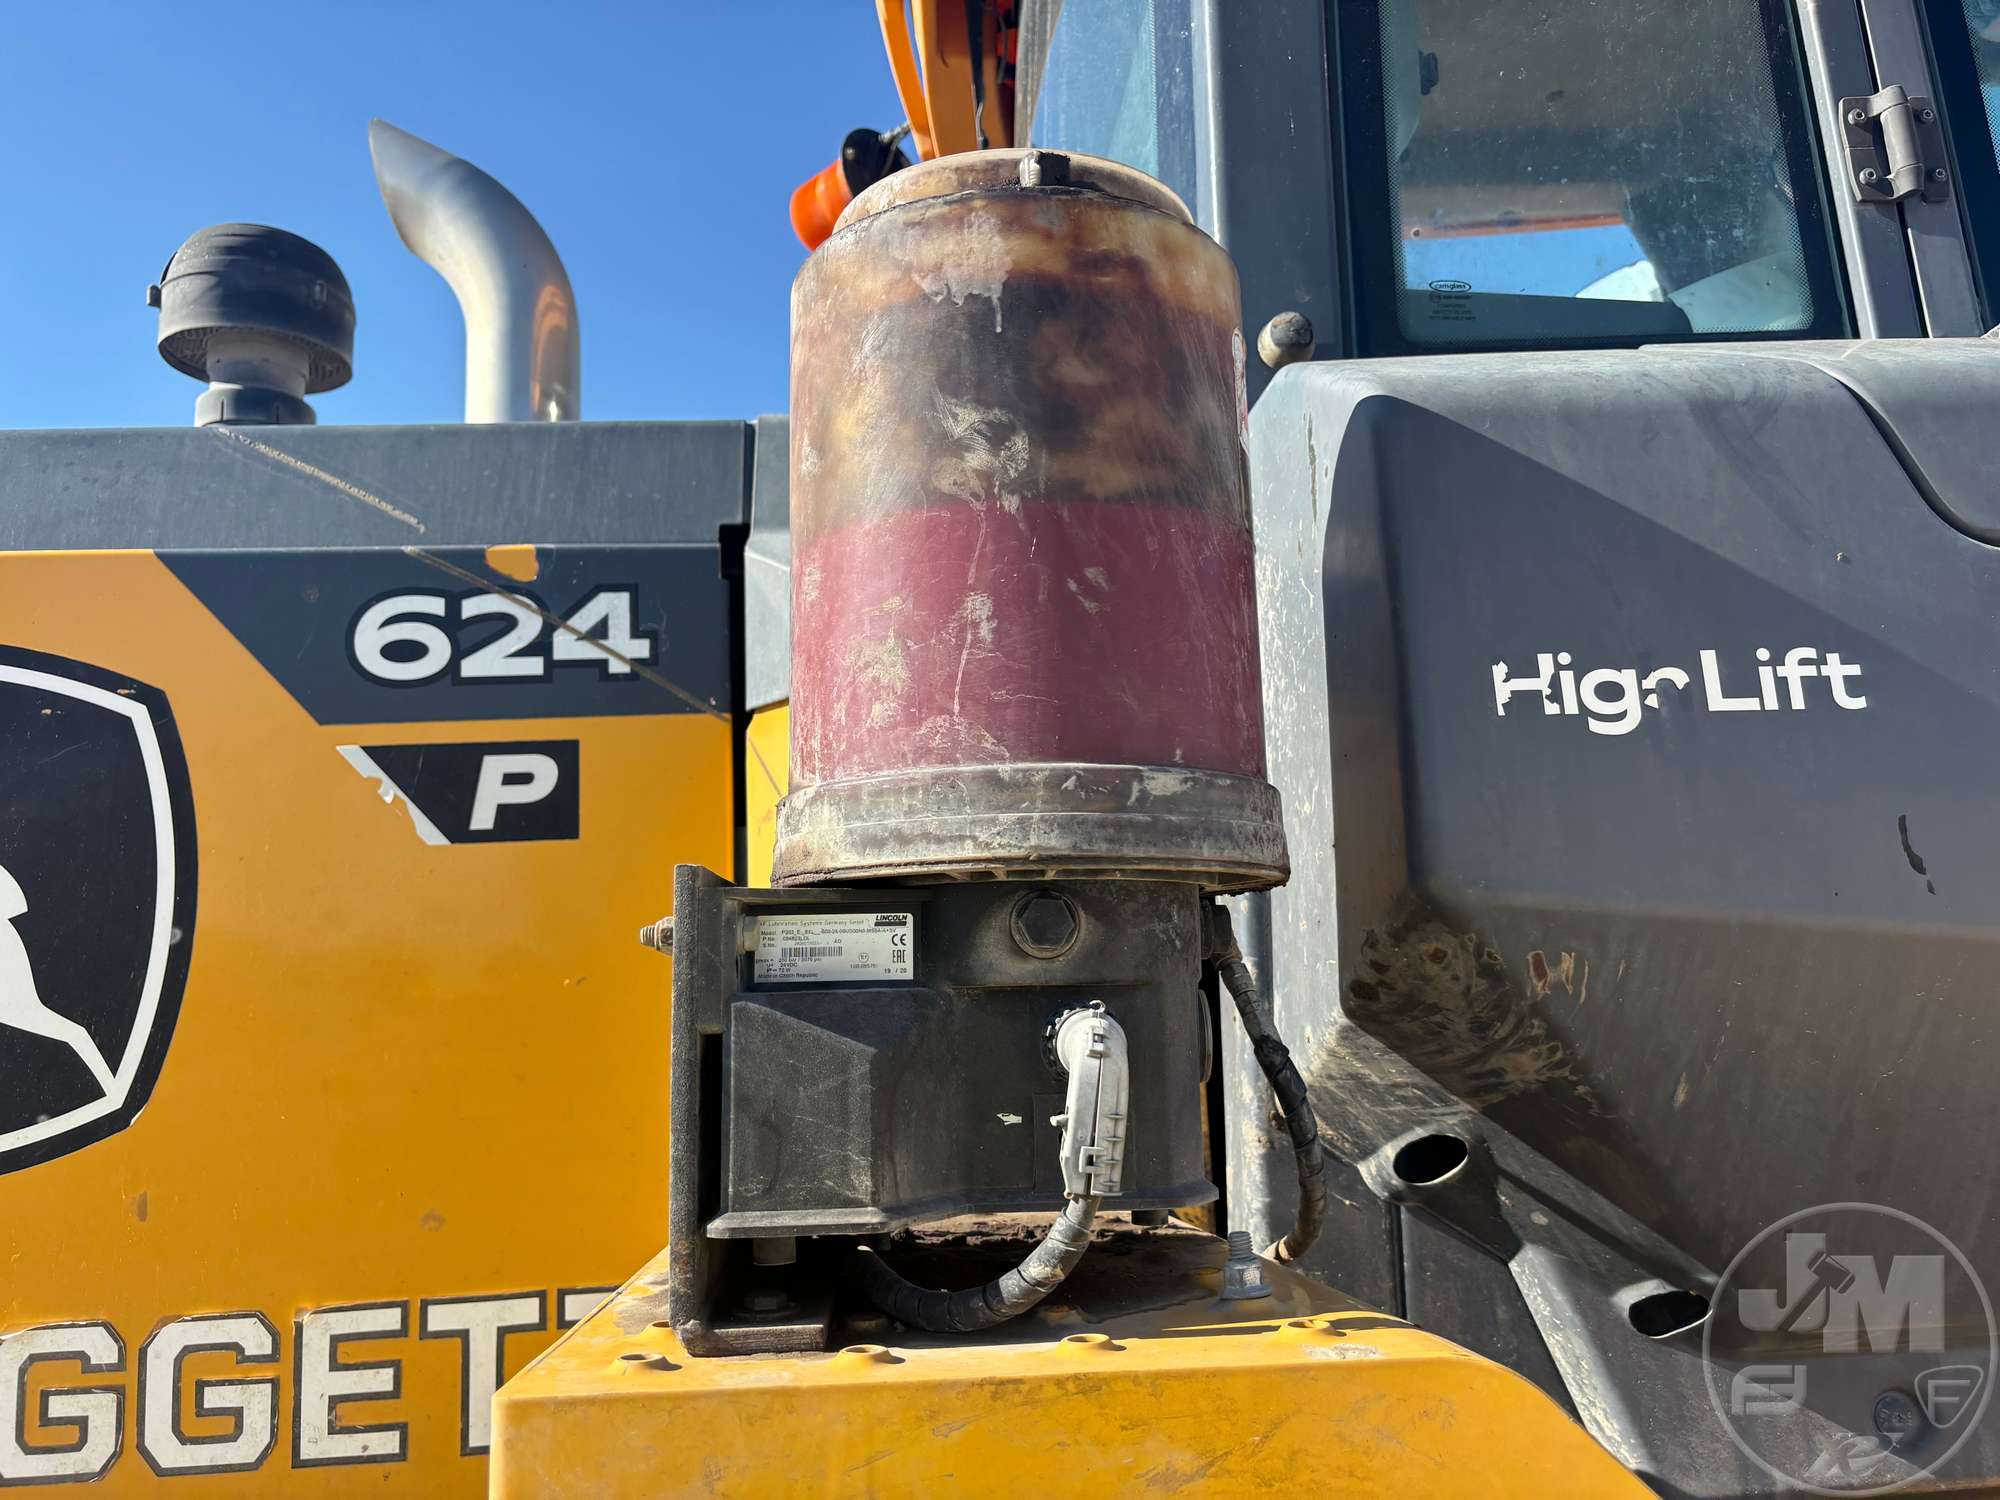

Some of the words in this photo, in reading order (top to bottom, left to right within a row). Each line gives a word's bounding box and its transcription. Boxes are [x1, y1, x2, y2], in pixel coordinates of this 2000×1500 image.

[353, 590, 651, 682] 624
[1699, 646, 1868, 712] Lift
[468, 753, 559, 831] P
[800, 919, 823, 927] Systems
[892, 949, 907, 963] EAC
[0, 1285, 632, 1486] GGET
